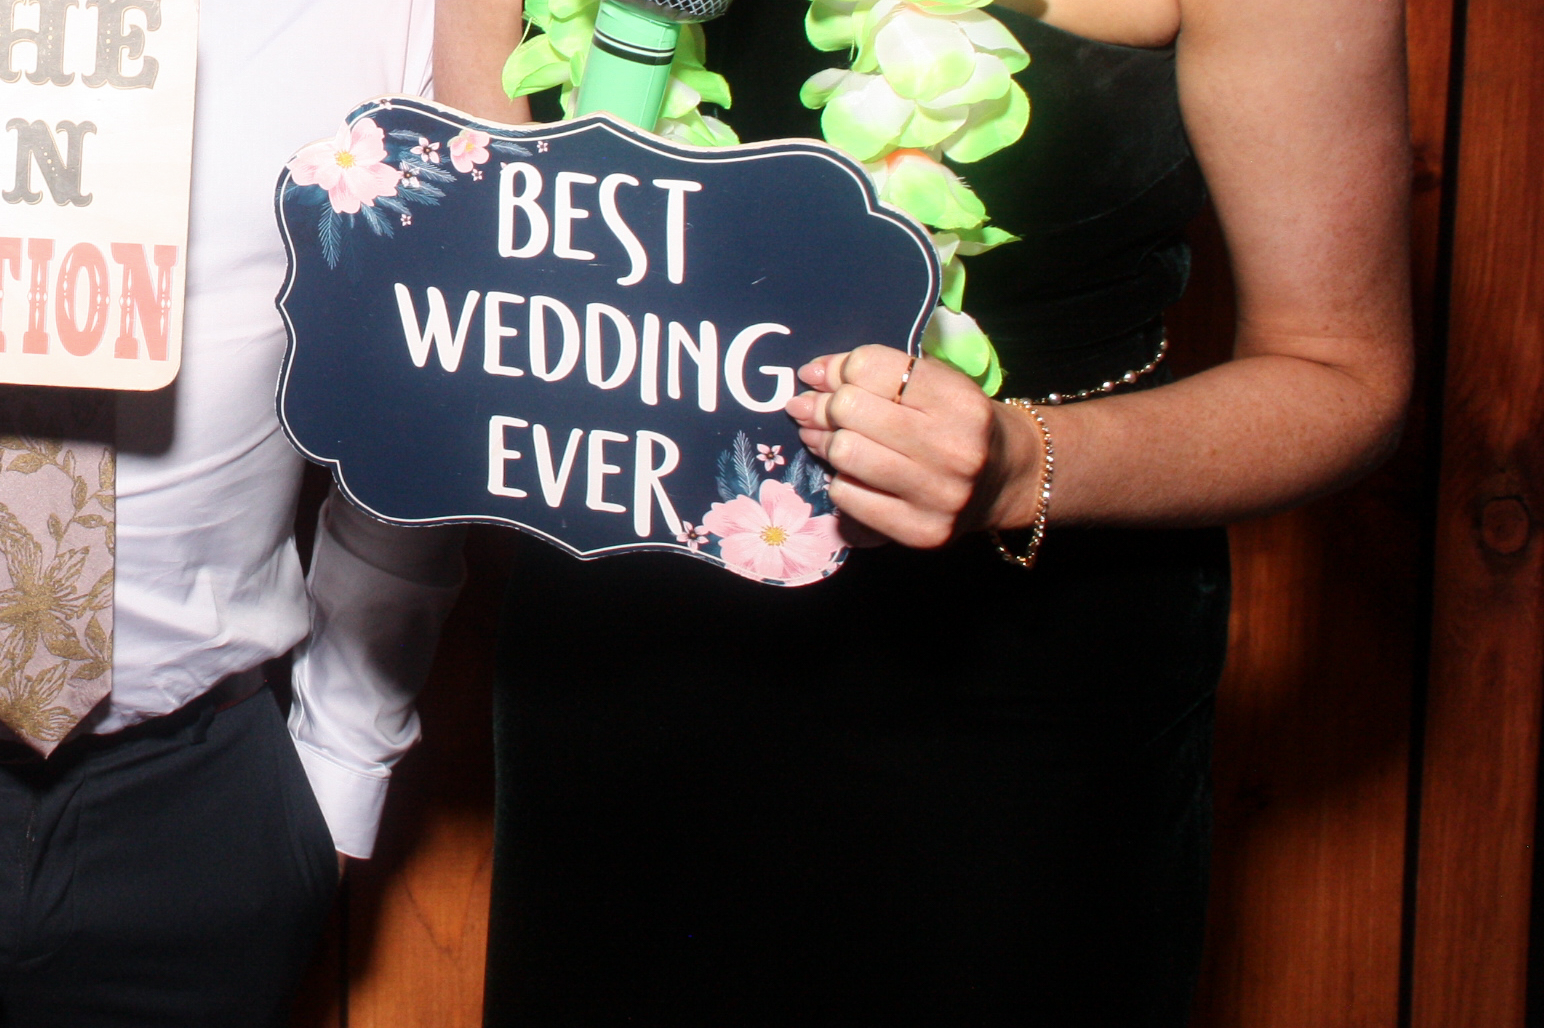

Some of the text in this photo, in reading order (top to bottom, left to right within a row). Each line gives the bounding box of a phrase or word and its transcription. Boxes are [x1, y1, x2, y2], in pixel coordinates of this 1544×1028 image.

[497, 161, 703, 286] BEST
[393, 282, 796, 413] WEDDING
[487, 415, 686, 538] EVER
